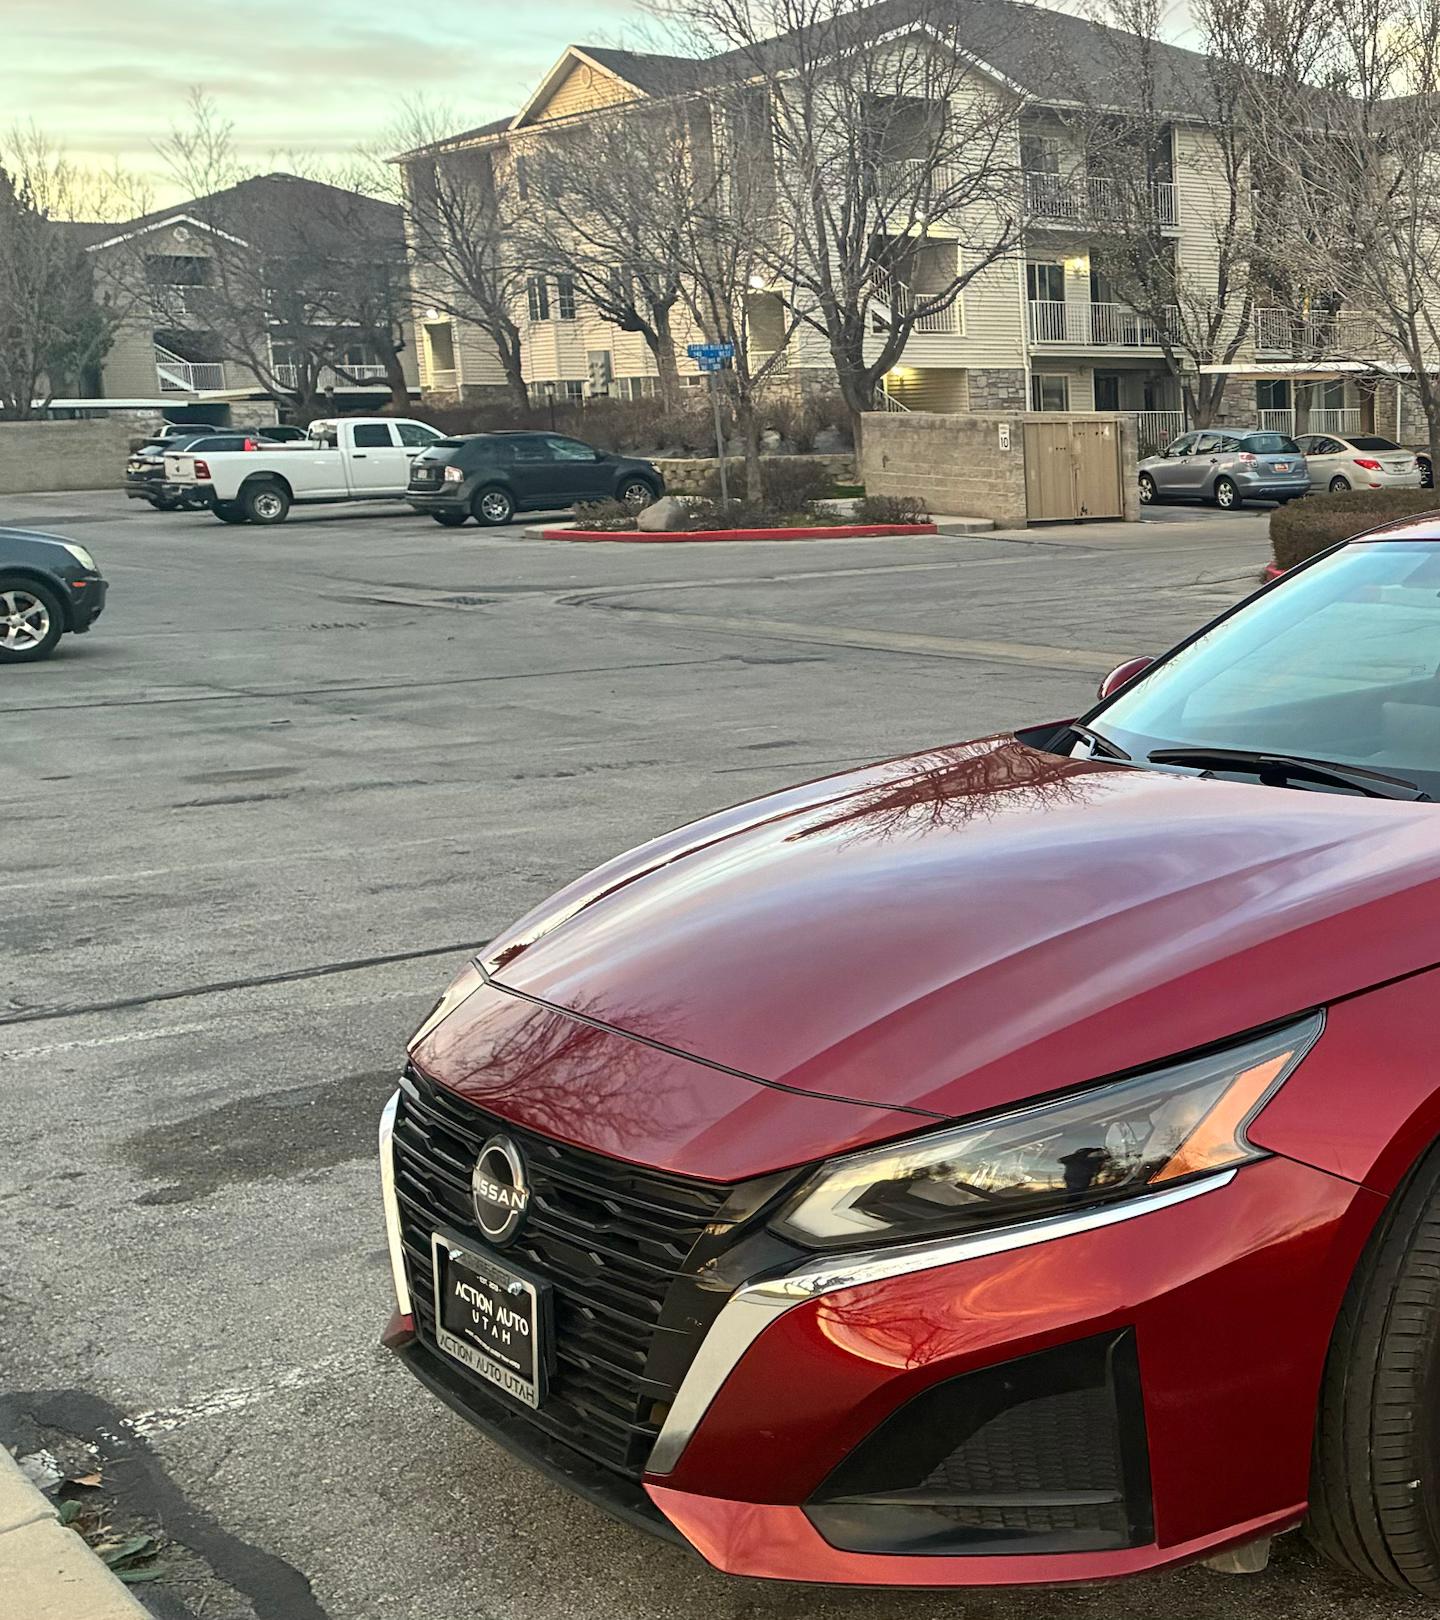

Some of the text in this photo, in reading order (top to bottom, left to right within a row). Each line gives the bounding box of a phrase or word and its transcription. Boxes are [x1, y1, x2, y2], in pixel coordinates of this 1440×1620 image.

[455, 1281, 493, 1316] ACTION
[496, 1306, 529, 1336] AUTO
[472, 1309, 511, 1345] UTAH
[440, 1335, 473, 1363] ACTION
[476, 1357, 502, 1381] AUTO
[504, 1373, 535, 1404] UTAH
